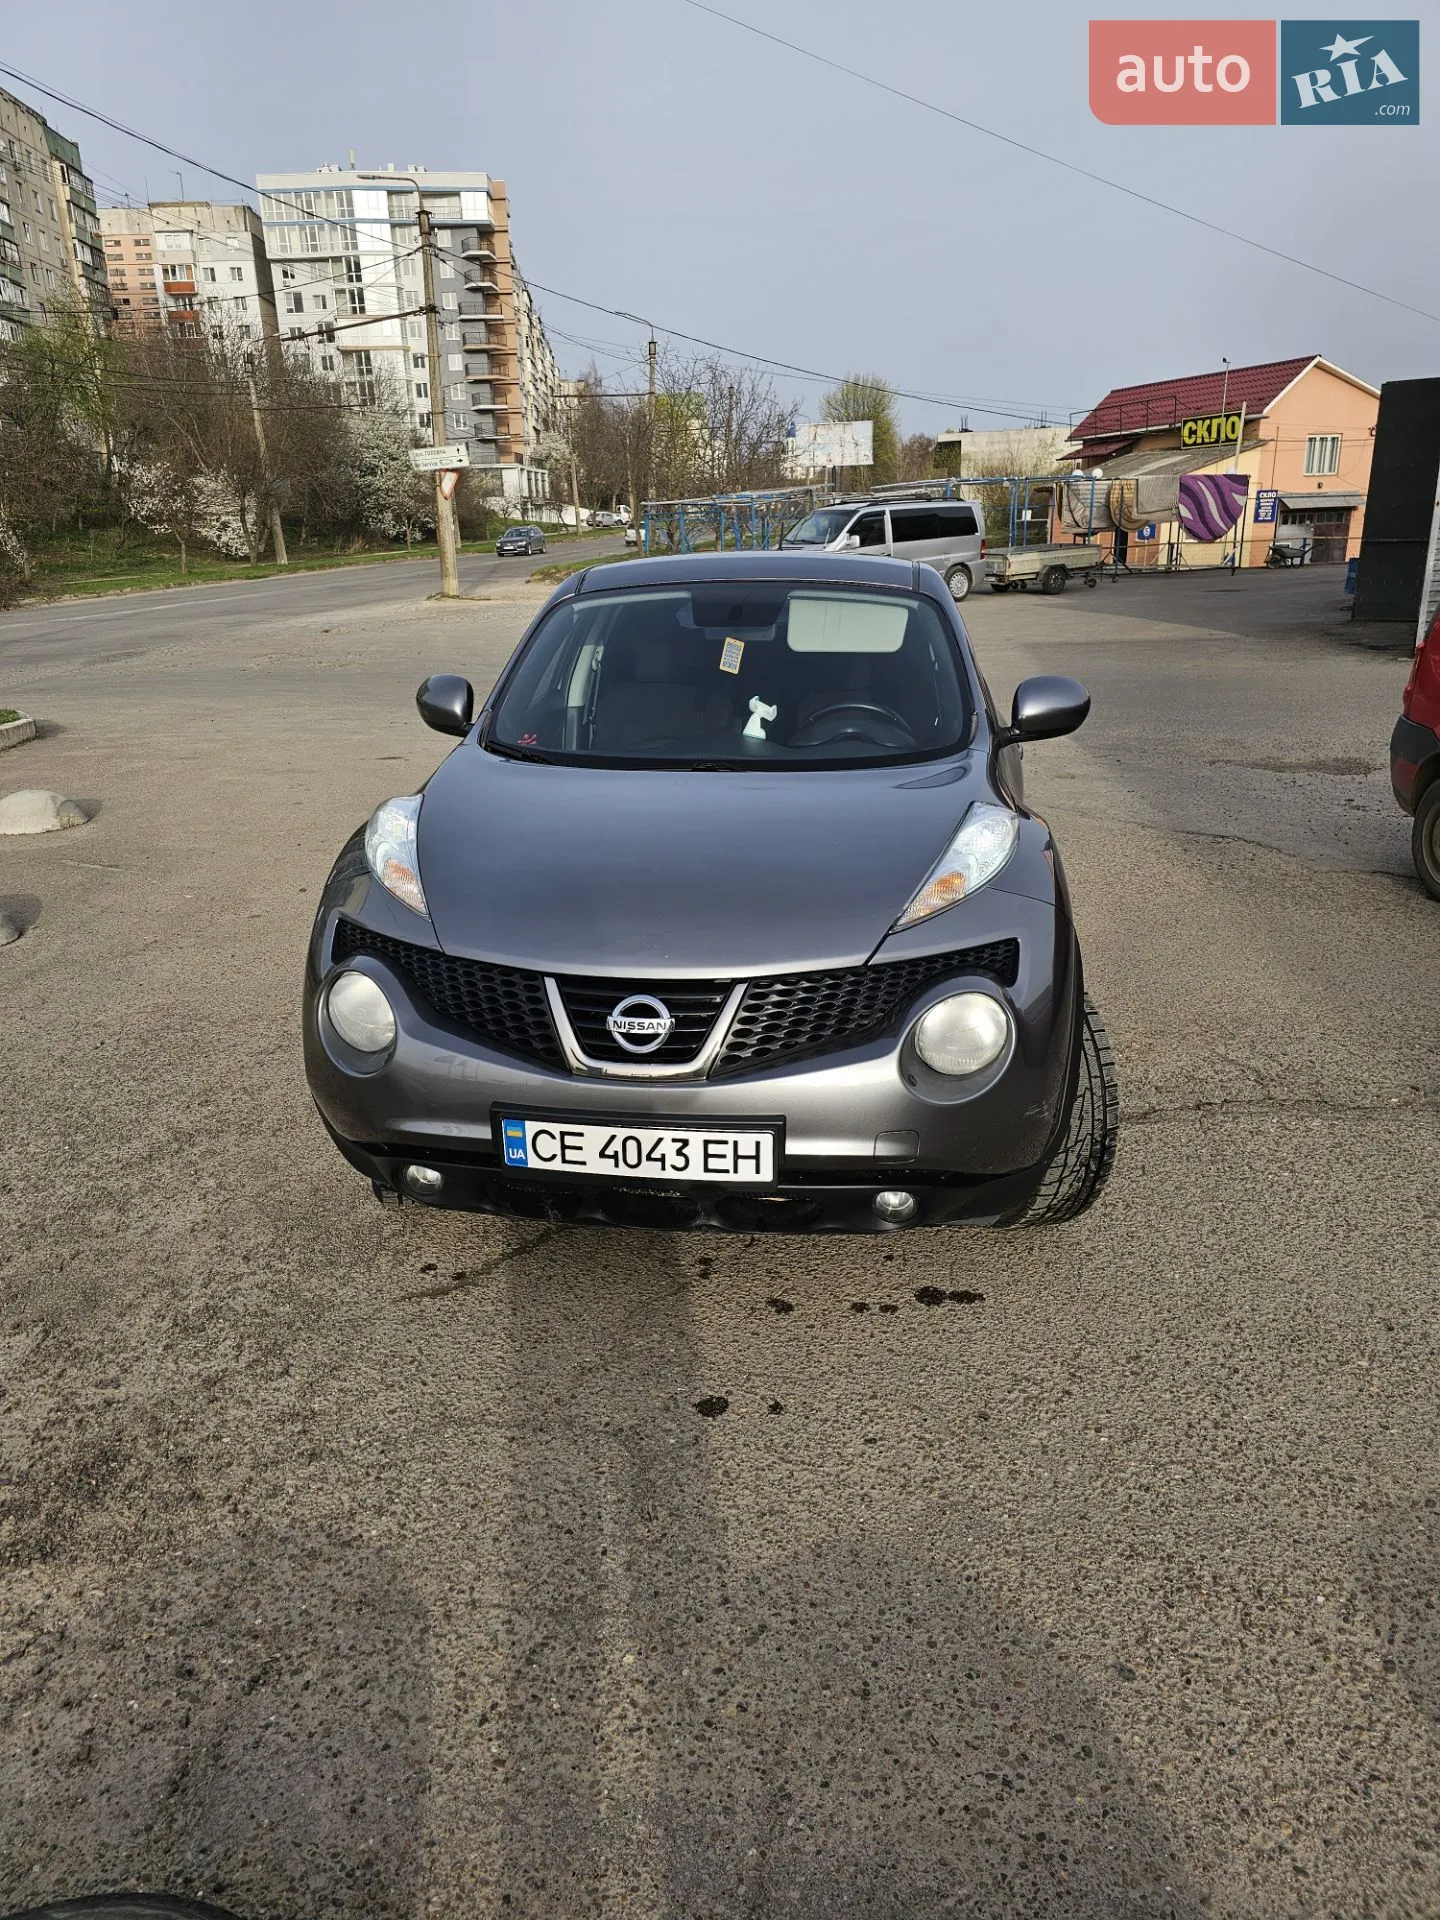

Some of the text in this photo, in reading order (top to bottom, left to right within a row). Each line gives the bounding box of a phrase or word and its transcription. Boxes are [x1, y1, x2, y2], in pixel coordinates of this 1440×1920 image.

[1183, 415, 1241, 445] СКЛО
[612, 1020, 667, 1032] NISSAN
[508, 1147, 526, 1160] UA
[531, 1129, 761, 1175] CE 4043 EH
